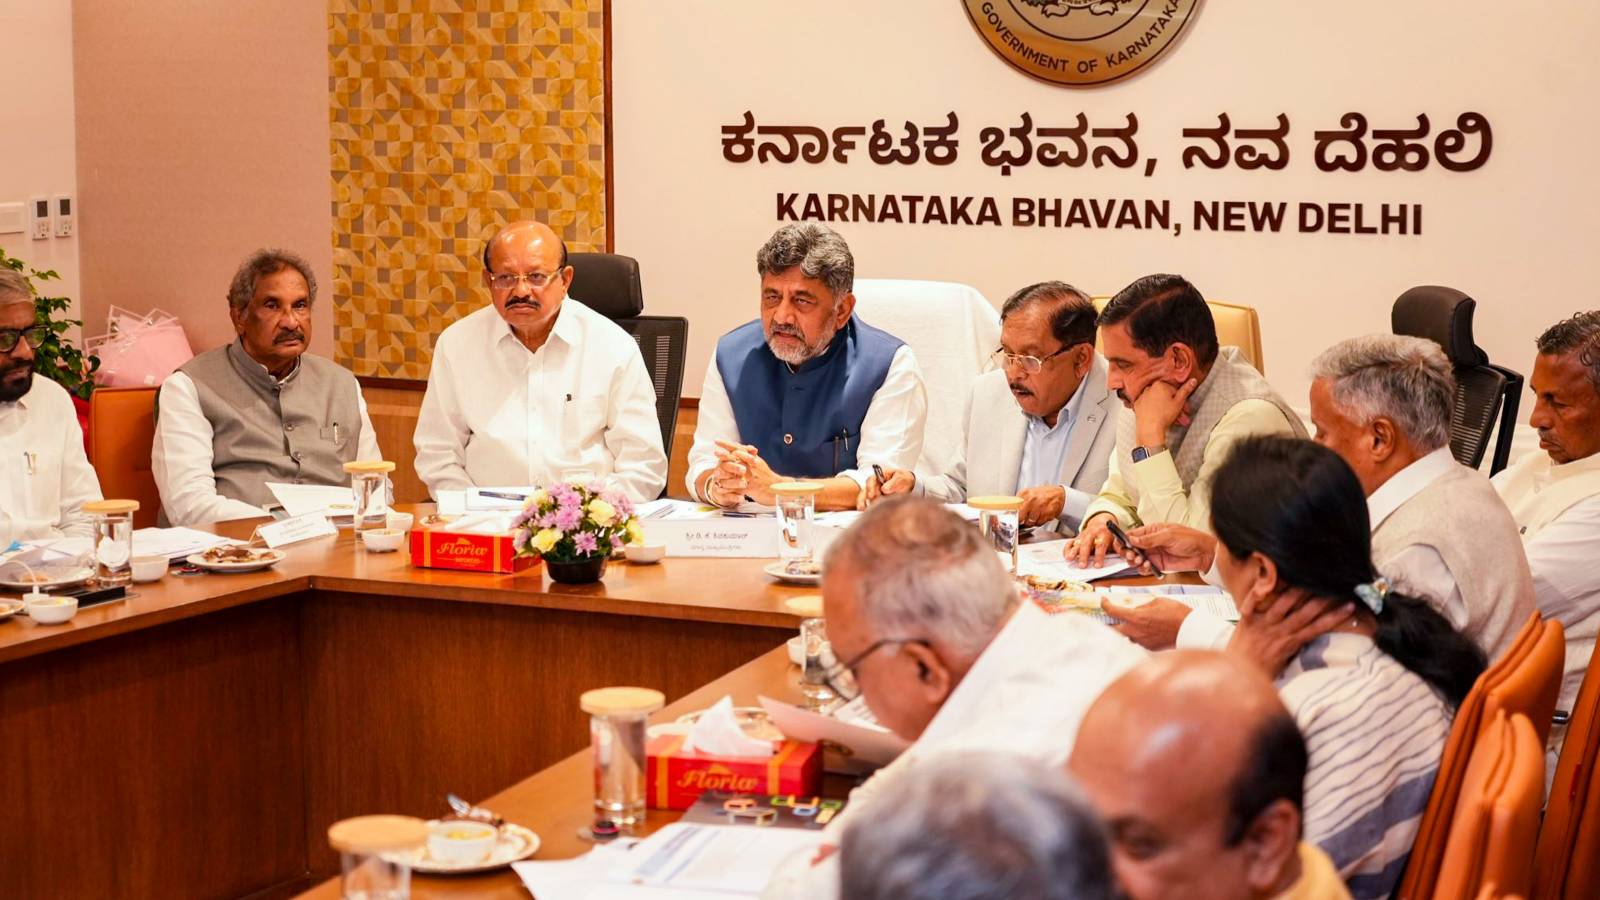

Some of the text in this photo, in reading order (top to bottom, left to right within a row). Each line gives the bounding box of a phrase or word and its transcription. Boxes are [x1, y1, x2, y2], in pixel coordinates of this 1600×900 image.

[981, 2, 1069, 72] GOVERNMENT
[1076, 59, 1098, 74] OF
[721, 110, 1493, 177] ಕರ್ನಾಟಕ ಭವನ, ನವ ದೆಹಲಿ
[776, 193, 1422, 237] KARNATAKA BHAVAN, NEW DELHI
